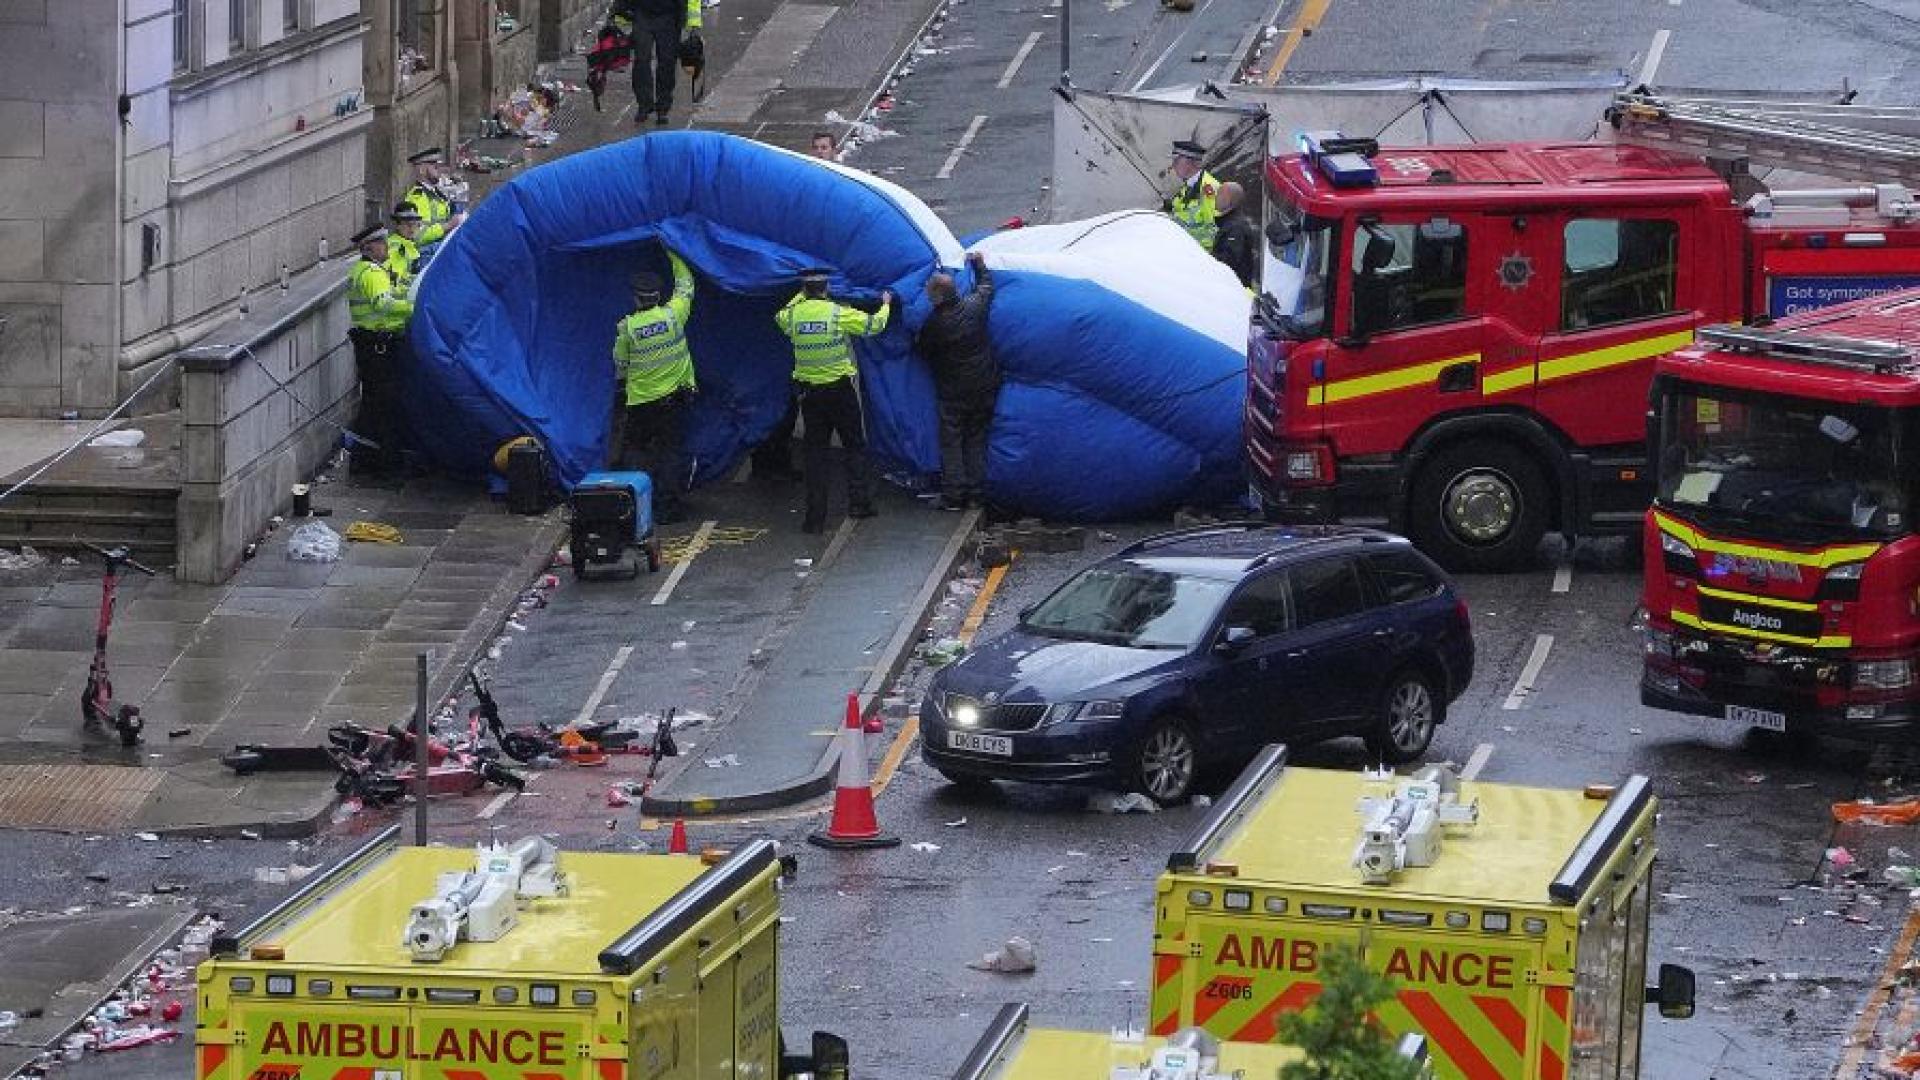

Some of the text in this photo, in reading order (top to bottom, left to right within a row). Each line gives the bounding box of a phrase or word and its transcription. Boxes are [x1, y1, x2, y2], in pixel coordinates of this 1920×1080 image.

[1786, 286, 1814, 299] Got
[1733, 608, 1781, 629] Angloco
[1214, 933, 1515, 989] AMBANCE
[260, 1020, 566, 1066] AMBULANCE
